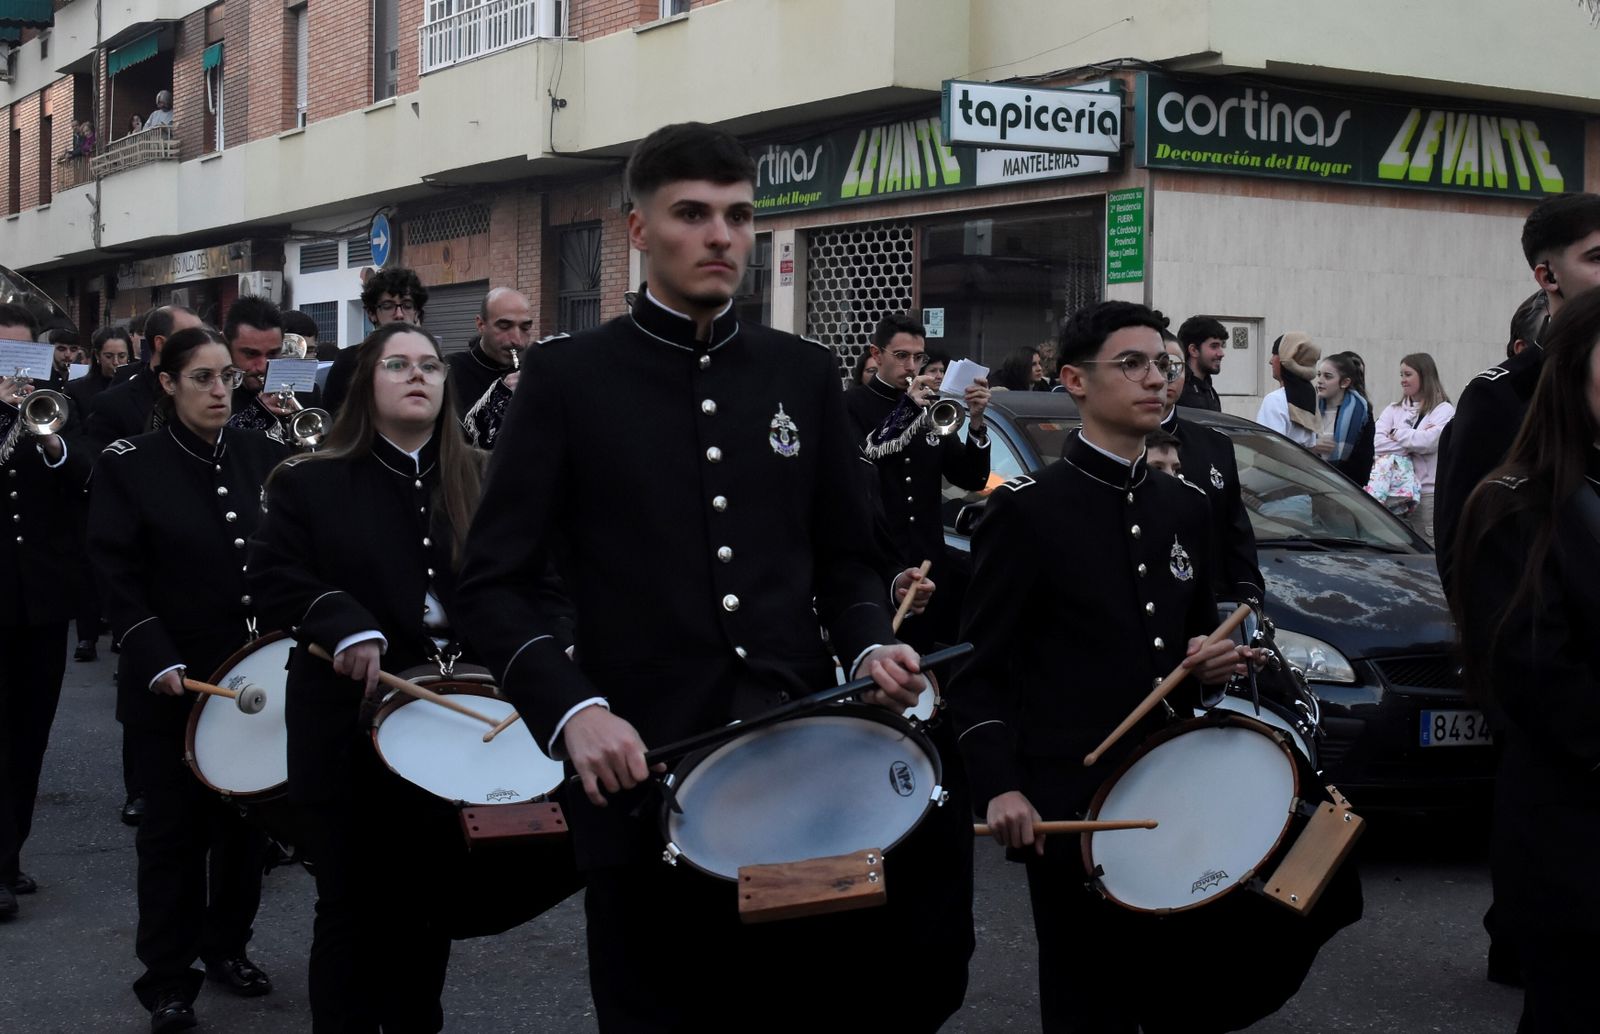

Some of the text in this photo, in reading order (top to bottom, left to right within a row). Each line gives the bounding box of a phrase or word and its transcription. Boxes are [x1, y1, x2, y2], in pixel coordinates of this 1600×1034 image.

[959, 89, 1118, 140] tapicería
[1157, 88, 1351, 147] cortinas
[756, 144, 823, 187] rtinas
[1155, 143, 1352, 177] Decoración del Hogar
[1378, 108, 1564, 193] LEVANTE
[776, 192, 791, 206] del
[792, 191, 822, 206] Hogar
[1117, 214, 1133, 223] FUERA
[1114, 237, 1136, 246] Provincia
[1434, 714, 1489, 741] 8434
